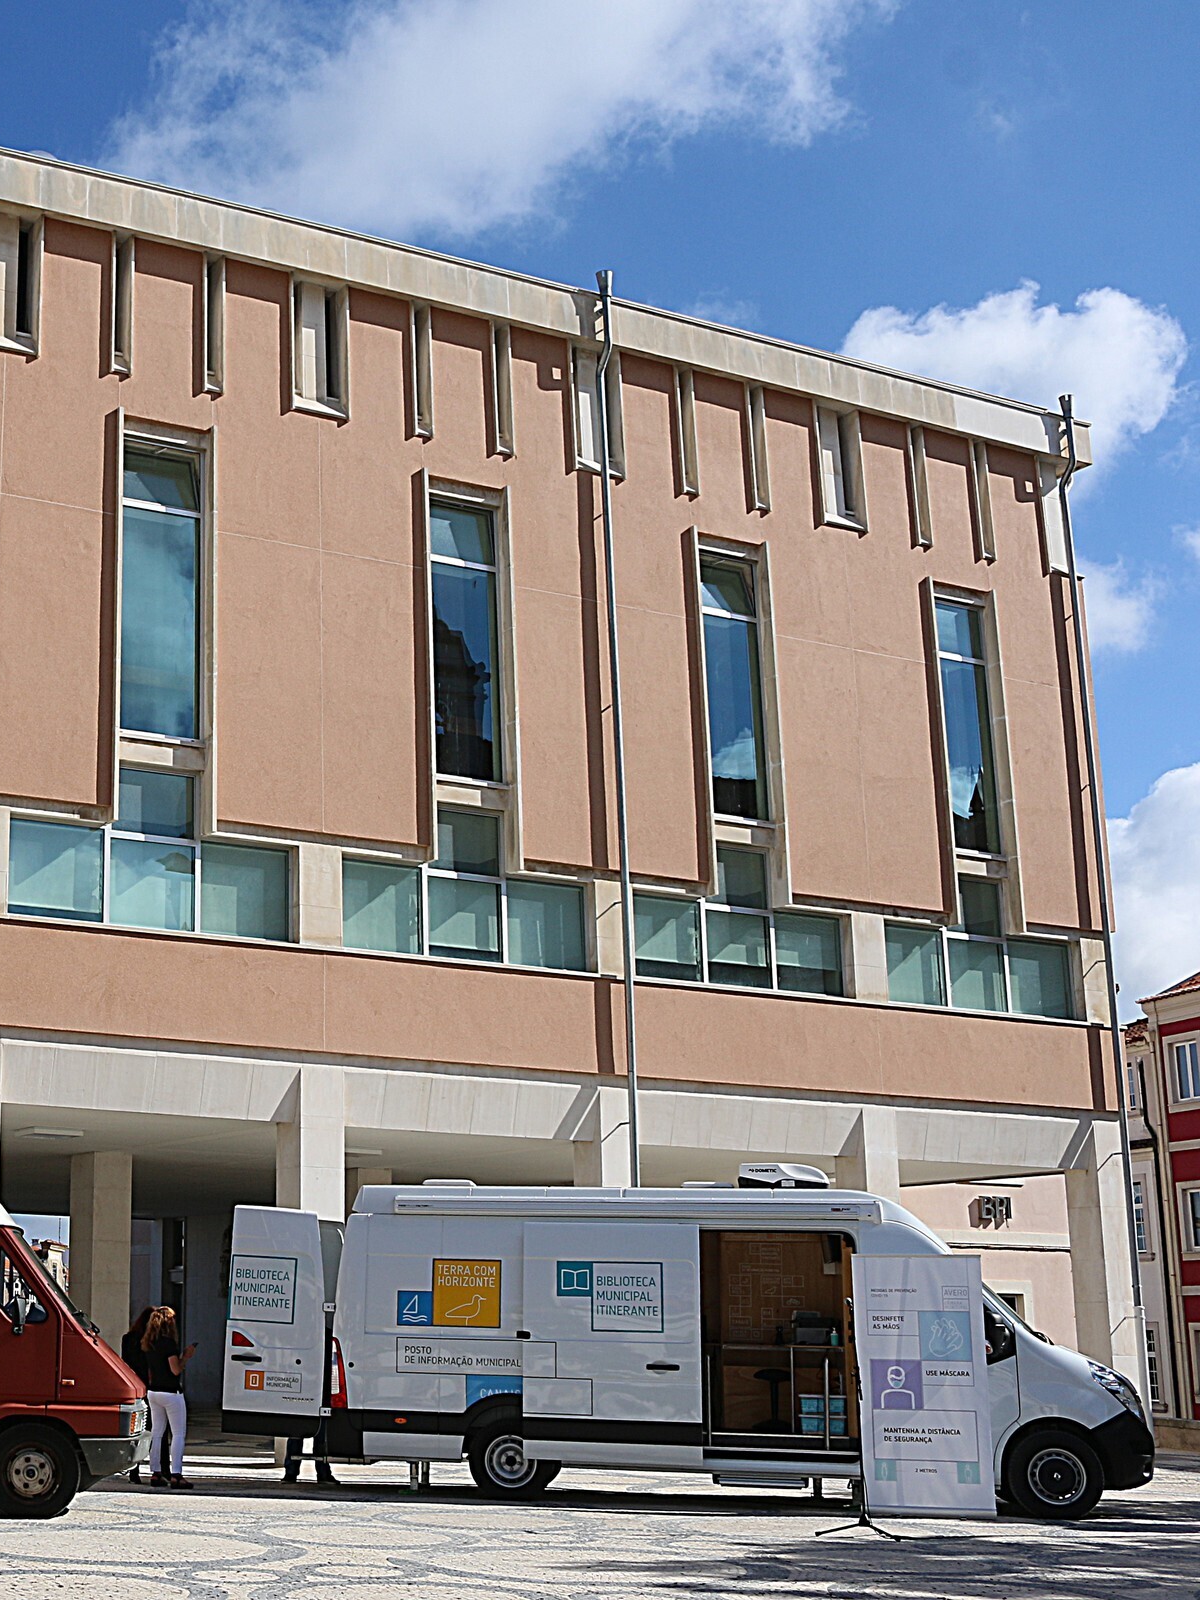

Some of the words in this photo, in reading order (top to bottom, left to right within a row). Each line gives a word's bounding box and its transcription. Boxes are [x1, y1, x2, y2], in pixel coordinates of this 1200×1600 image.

[236, 1268, 290, 1281] BIBLIOTECA
[438, 1264, 471, 1275] TERRA
[473, 1265, 496, 1276] COM
[438, 1276, 496, 1288] HORIZONTE
[596, 1275, 656, 1287] BIBLIOTECA
[234, 1282, 286, 1295] MUNICIPAL
[233, 1295, 290, 1309] ITINERANTE
[596, 1290, 653, 1302] MUNICIPAL
[596, 1305, 659, 1316] ITINERANTE
[404, 1345, 432, 1355] POSTO
[404, 1355, 415, 1364] DE
[418, 1356, 473, 1367] INFORMAÇÃO
[475, 1358, 522, 1368] MUNICIPAL
[939, 1368, 970, 1377] MÁSCARA
[266, 1375, 299, 1384] INFORMAÇÃO
[928, 1427, 961, 1435] DISTÂNCIA
[894, 1436, 933, 1444] SEGURANÇA
